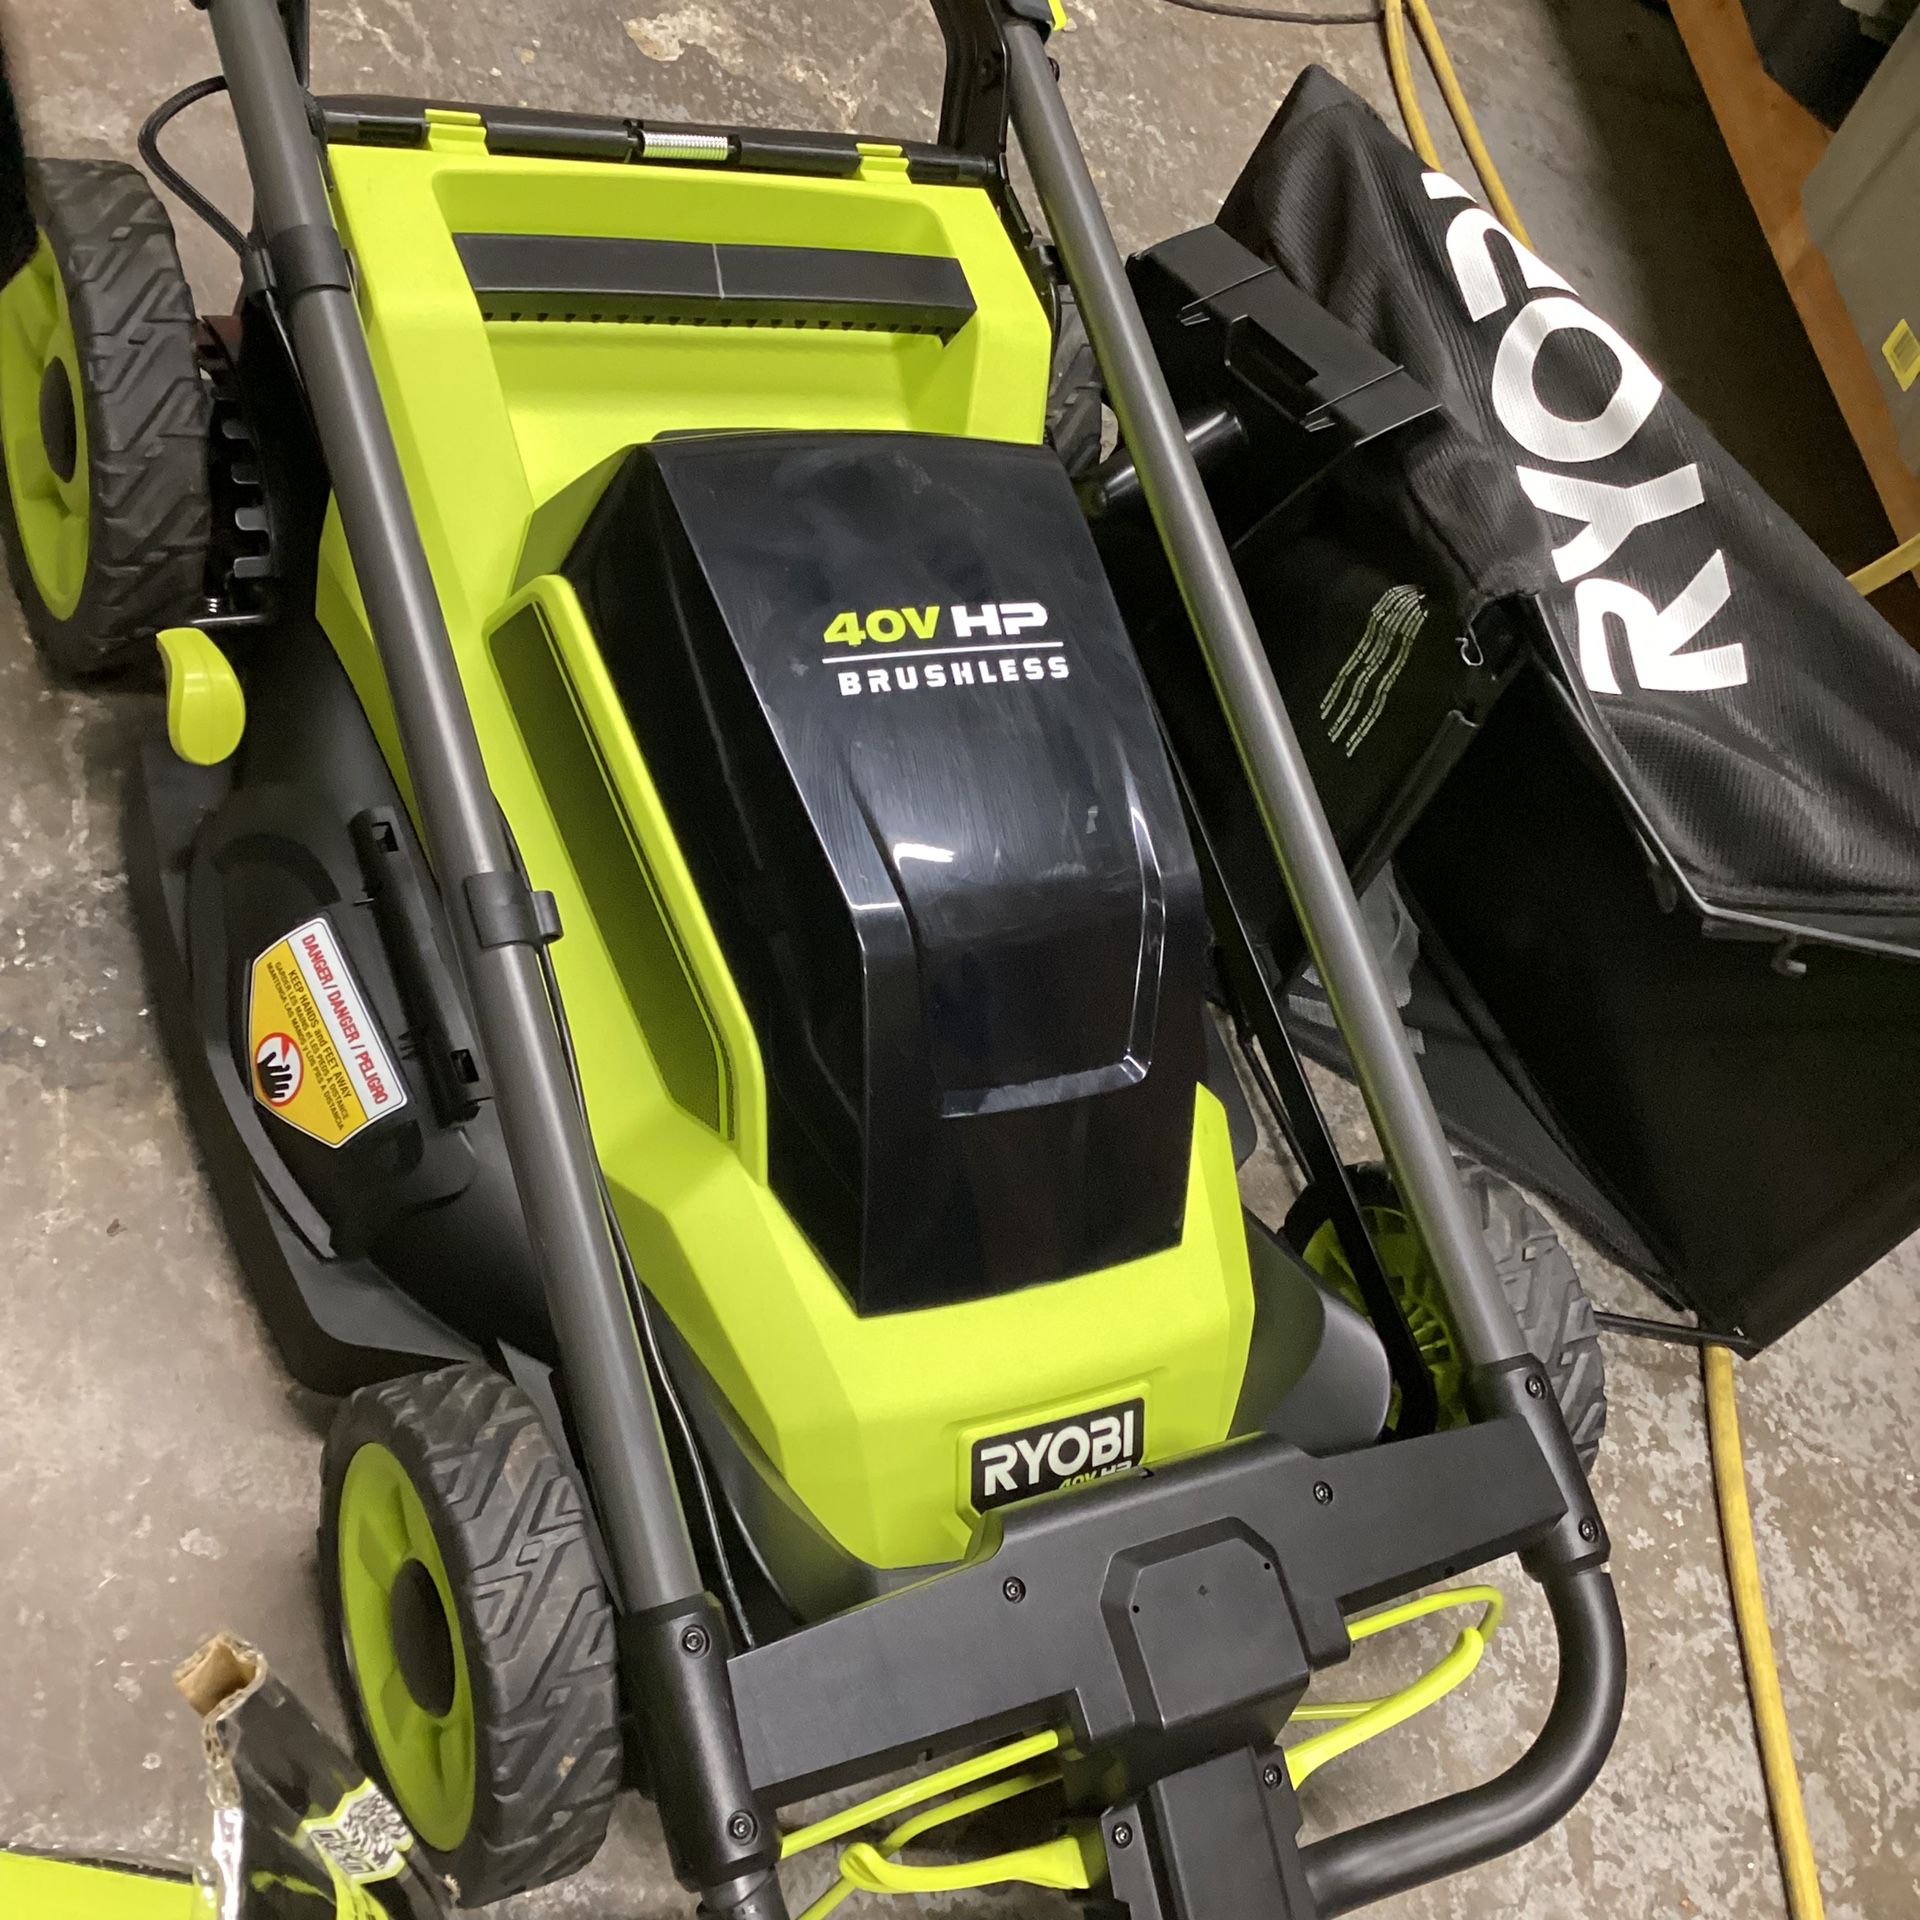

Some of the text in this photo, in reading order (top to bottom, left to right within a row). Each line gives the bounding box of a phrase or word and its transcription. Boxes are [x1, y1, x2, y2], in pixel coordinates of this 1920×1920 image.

[823, 601, 1048, 646] 40V HP
[837, 656, 1069, 696] BRUSHLESS
[288, 970, 351, 1098] KEEP HANDS and FEET AWAY
[301, 933, 333, 986] DANGER
[326, 990, 359, 1043] DANGER
[355, 1051, 388, 1105] PELIGRO
[323, 1091, 344, 1131] DISTANCIA
[329, 1083, 349, 1119] DISTANCE
[981, 1410, 1135, 1496] RYOBI
